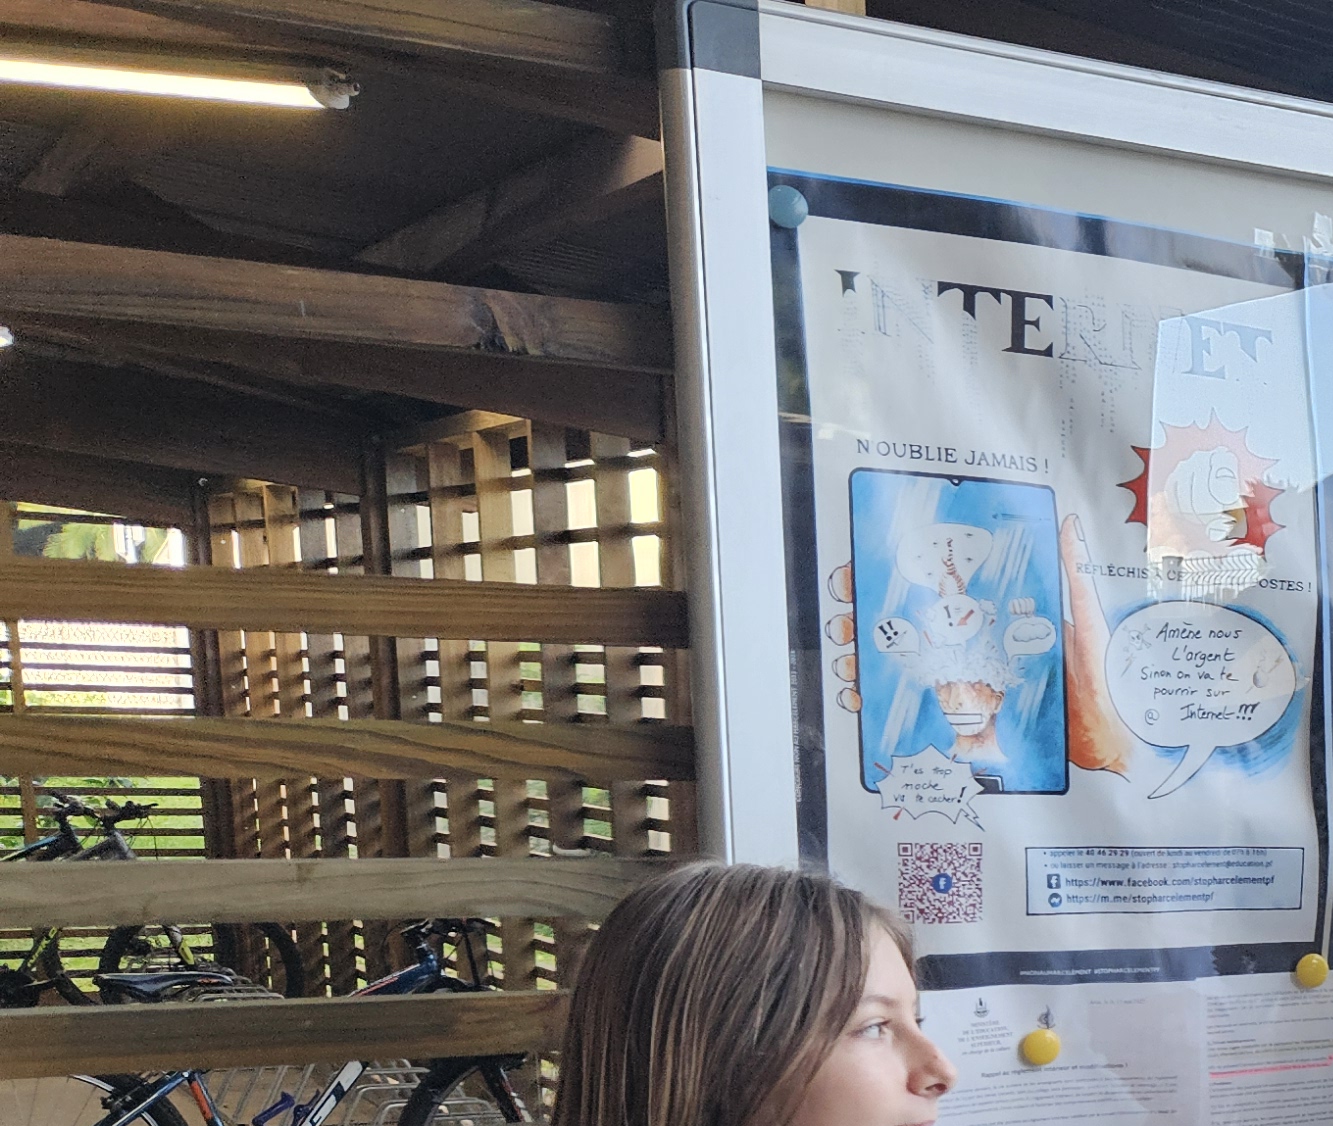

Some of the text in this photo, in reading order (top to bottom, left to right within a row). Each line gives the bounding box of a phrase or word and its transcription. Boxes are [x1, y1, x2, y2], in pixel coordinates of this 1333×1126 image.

[856, 439, 958, 463] N'OUBLIE
[964, 450, 1038, 472] JAMAIS
[1258, 577, 1304, 591] OSTES
[1155, 621, 1242, 642] Amène nous
[1172, 647, 1236, 668] L'argent
[1140, 666, 1239, 682] Sinon on va te
[1153, 687, 1230, 700] pourrir sur
[900, 763, 953, 778] T'es trop
[901, 781, 944, 791] moche
[915, 794, 925, 803] te
[1096, 862, 1130, 870] message
[1137, 861, 1167, 869] l'adresse
[1065, 875, 1275, 889] https://www.facebook.com/stopharcelementpf
[1066, 891, 1215, 905] https://m.me/stopharcelementpf
